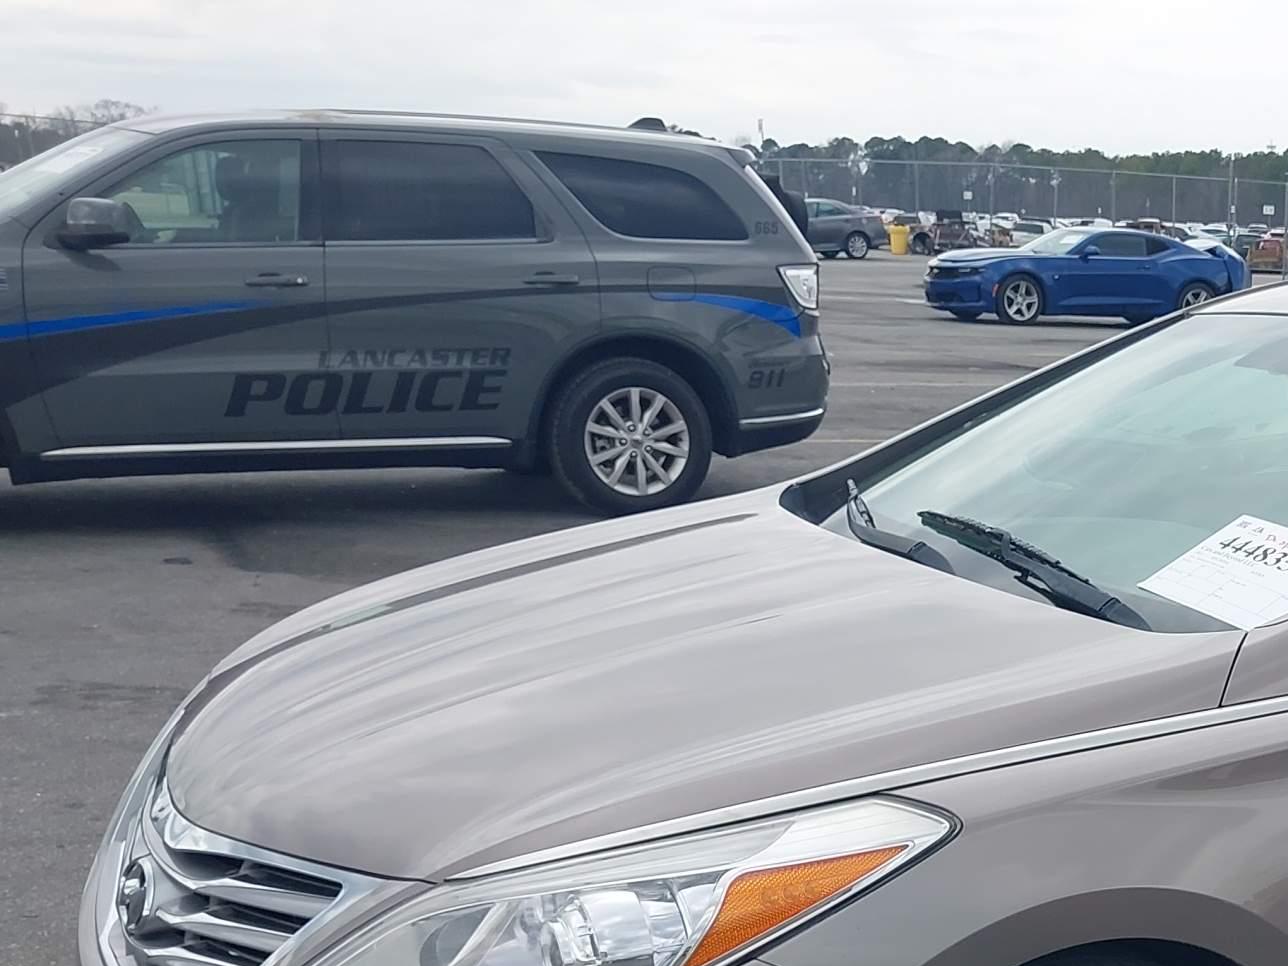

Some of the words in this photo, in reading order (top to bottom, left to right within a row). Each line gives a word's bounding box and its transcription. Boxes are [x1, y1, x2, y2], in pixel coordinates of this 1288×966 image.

[317, 347, 511, 369] LANCASTER
[748, 368, 785, 389] 911
[224, 368, 508, 417] POLICE
